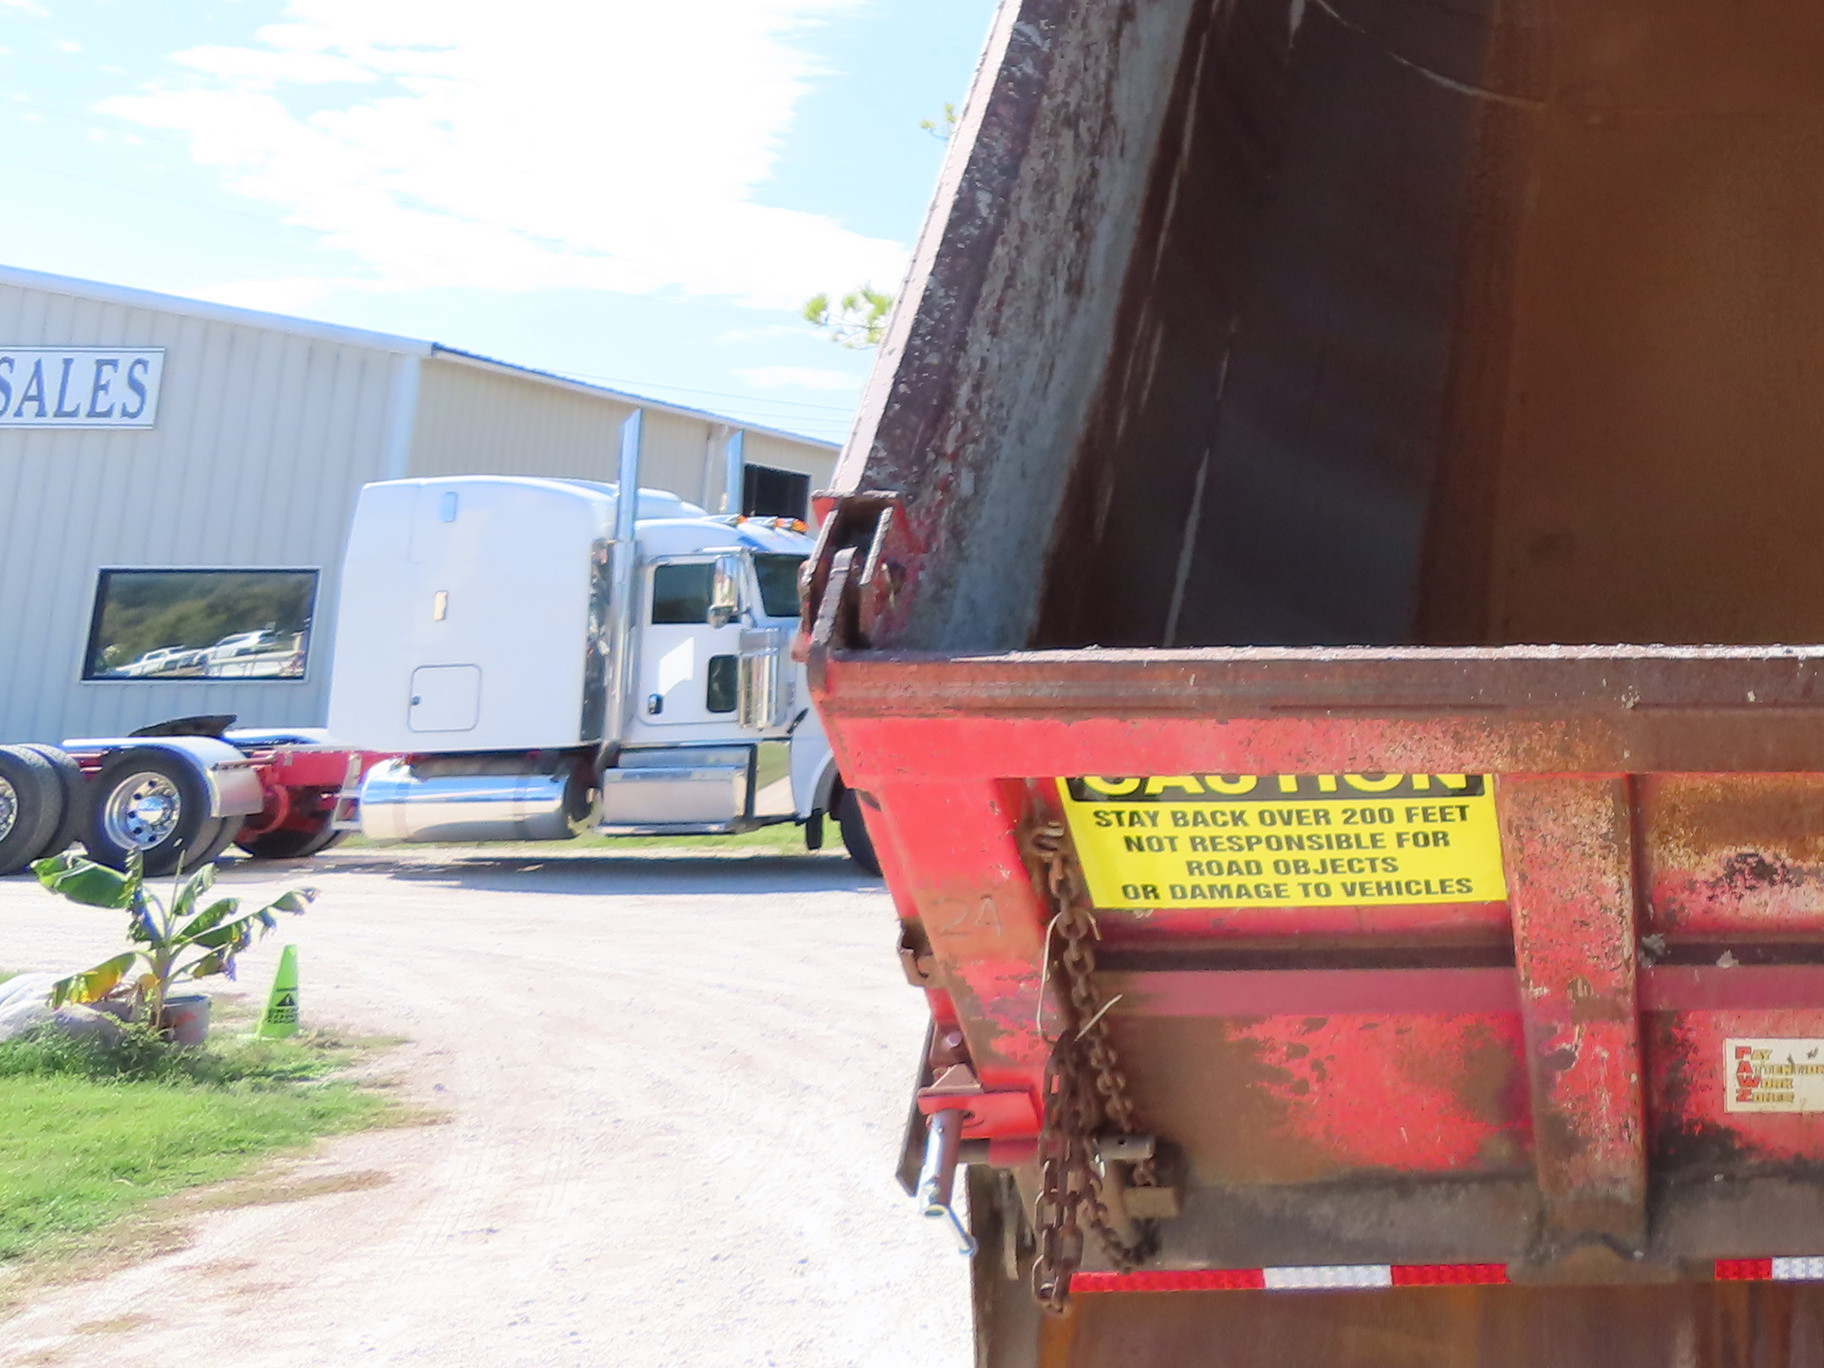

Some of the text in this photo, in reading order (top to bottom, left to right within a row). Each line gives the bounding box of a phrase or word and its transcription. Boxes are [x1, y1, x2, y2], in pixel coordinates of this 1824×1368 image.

[0, 356, 150, 419] SALES
[1093, 805, 1469, 827] STAY BACK OVER 200 FEET
[1124, 832, 1449, 852] NOT RESPONSIBLE FOR
[1187, 857, 1398, 876] ROAD OBJECTS
[1122, 879, 1472, 899] OR DAMAGE TO VEHICLES
